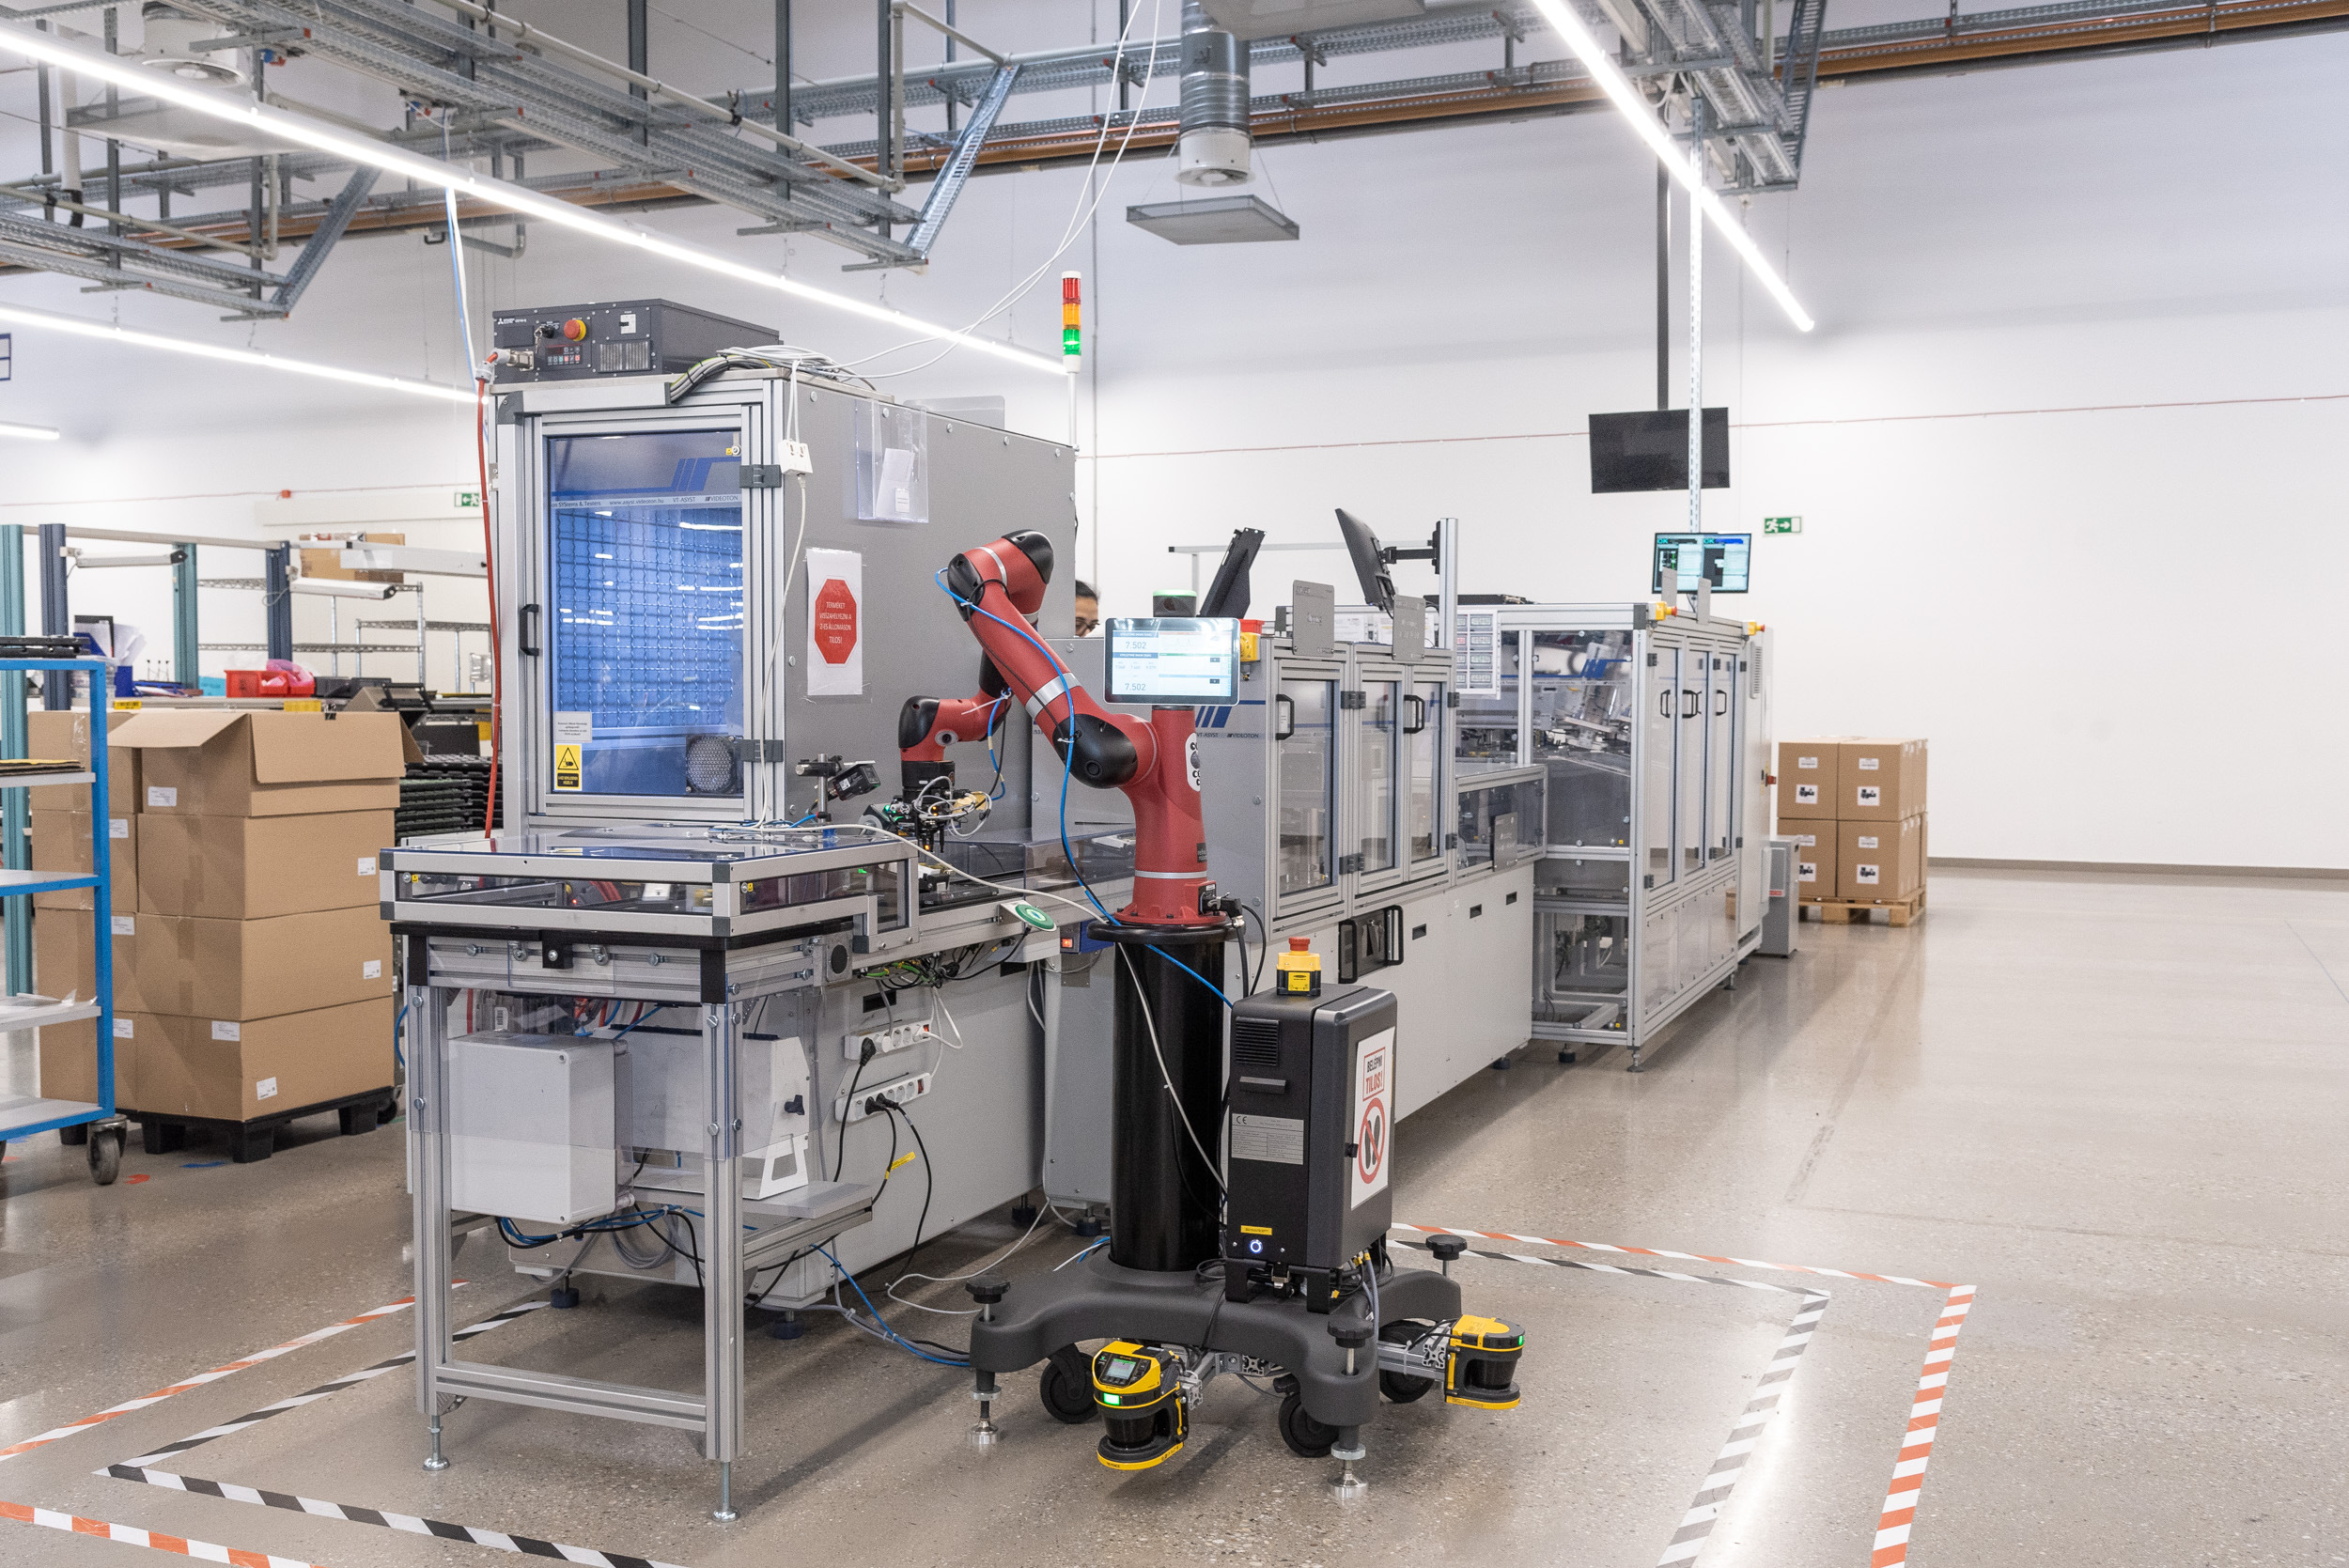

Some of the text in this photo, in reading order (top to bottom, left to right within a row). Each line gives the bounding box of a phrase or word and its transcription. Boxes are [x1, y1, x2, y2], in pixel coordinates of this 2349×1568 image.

[1126, 641, 1146, 649] 7.502
[1125, 683, 1146, 691] 7.502
[1367, 1055, 1382, 1073] BELÉPNI
[1366, 1071, 1383, 1094] TILOS!
